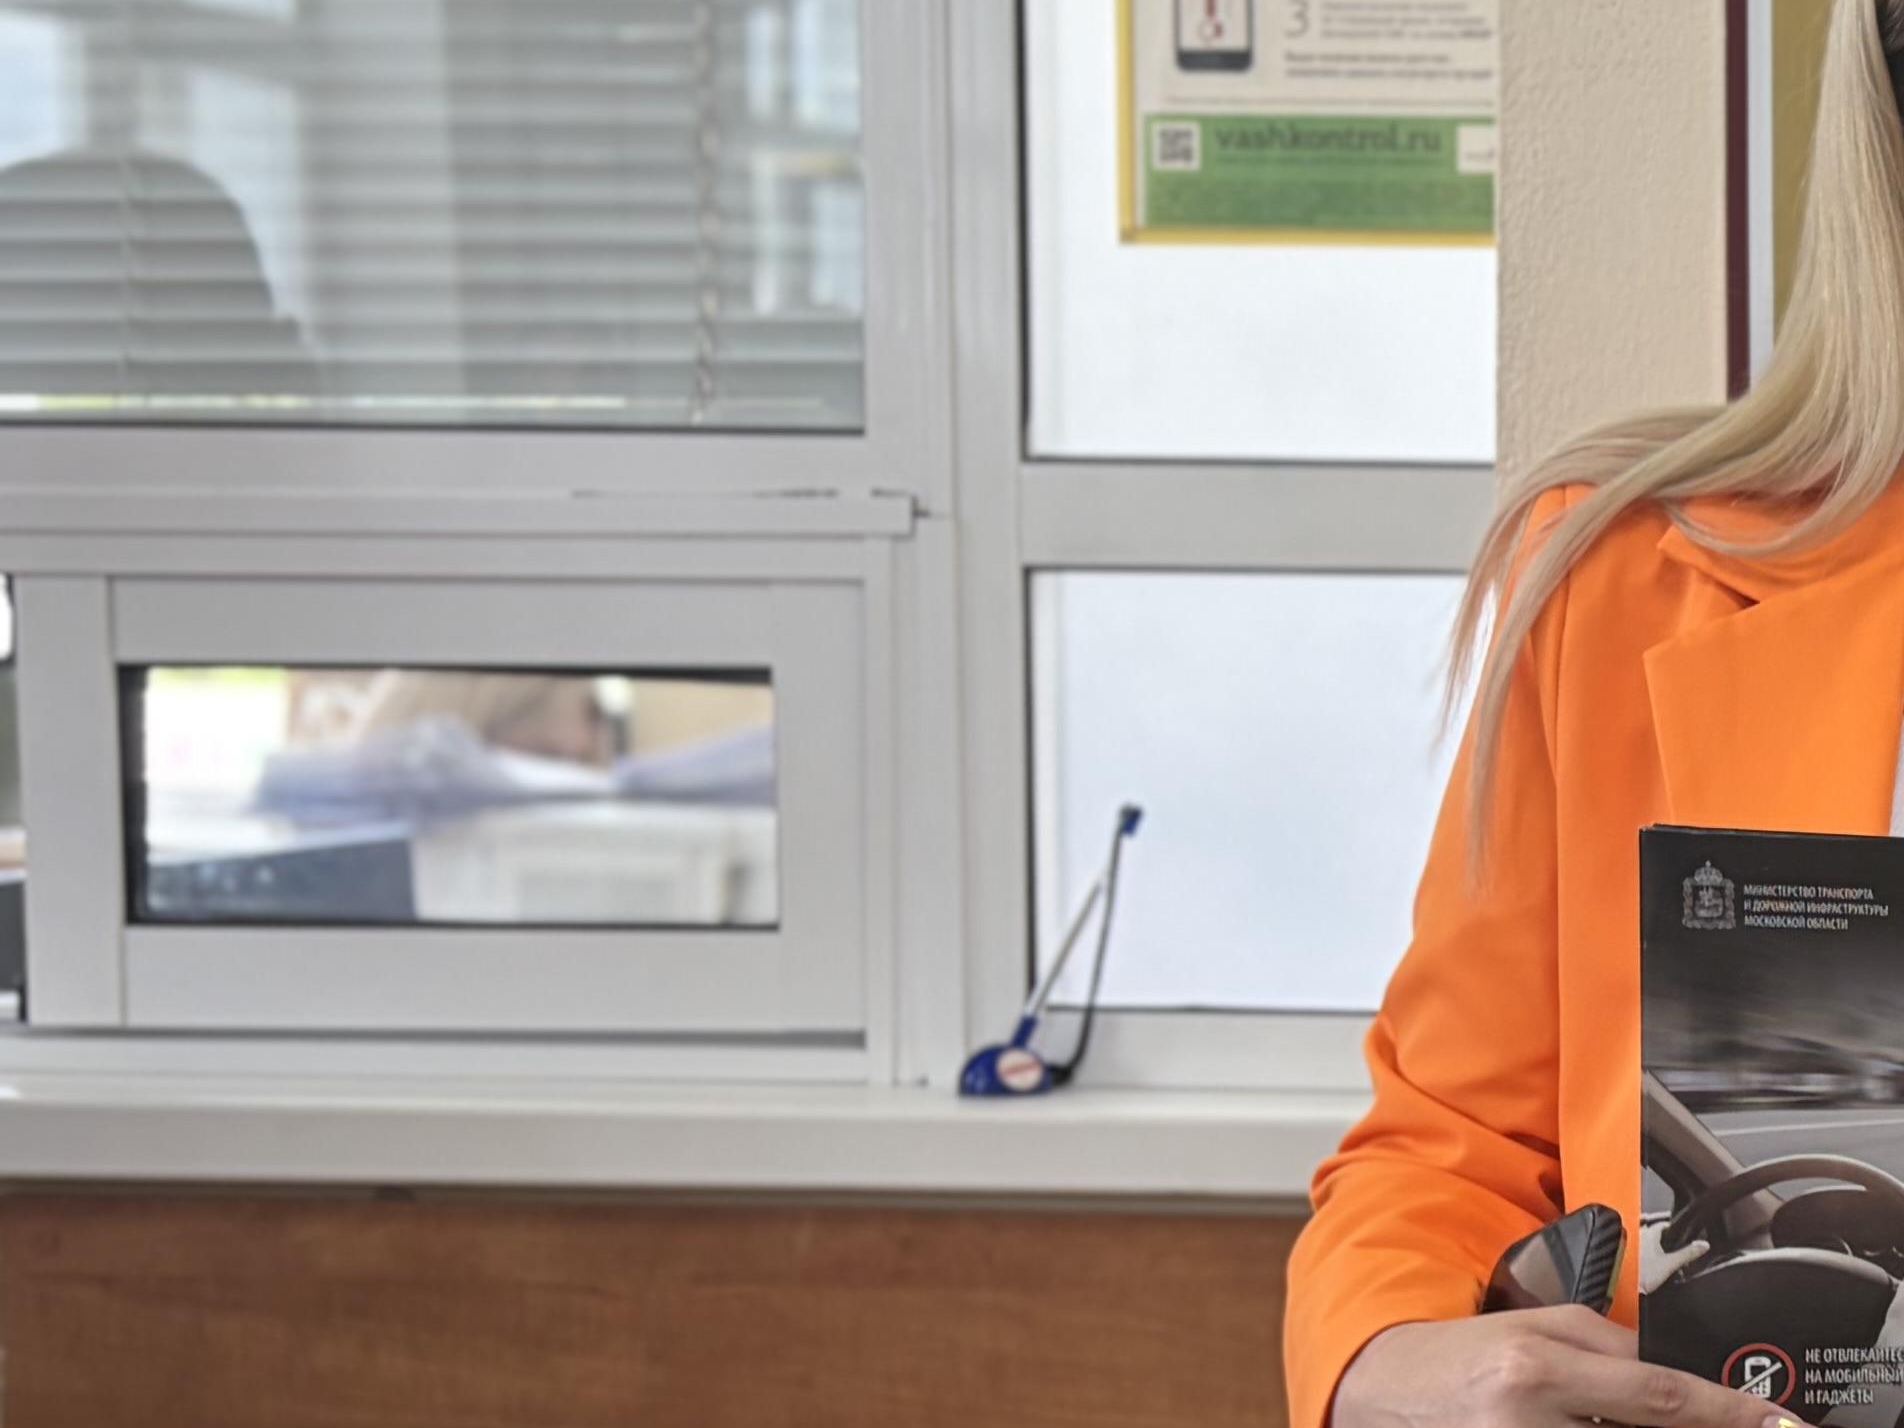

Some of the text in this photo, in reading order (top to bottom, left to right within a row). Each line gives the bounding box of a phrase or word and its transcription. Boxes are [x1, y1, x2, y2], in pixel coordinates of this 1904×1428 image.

[1744, 884, 1873, 900] МИНИСТЕРСТВО ТРАНСПОРТА
[1753, 899, 1806, 915] ДОРОЖНОЙ
[1807, 903, 1889, 917] ИНФРАСТРУКТУРЫ
[1744, 915, 1848, 930] МОСКОВСКОЙ ОБЛАСТИ
[1805, 1348, 1821, 1364] НЕ
[1805, 1370, 1823, 1384] НА
[1825, 1368, 1904, 1385] МОБИЛЬНЫЙ
[1816, 1390, 1874, 1406] ГАДЖЕТЫ
